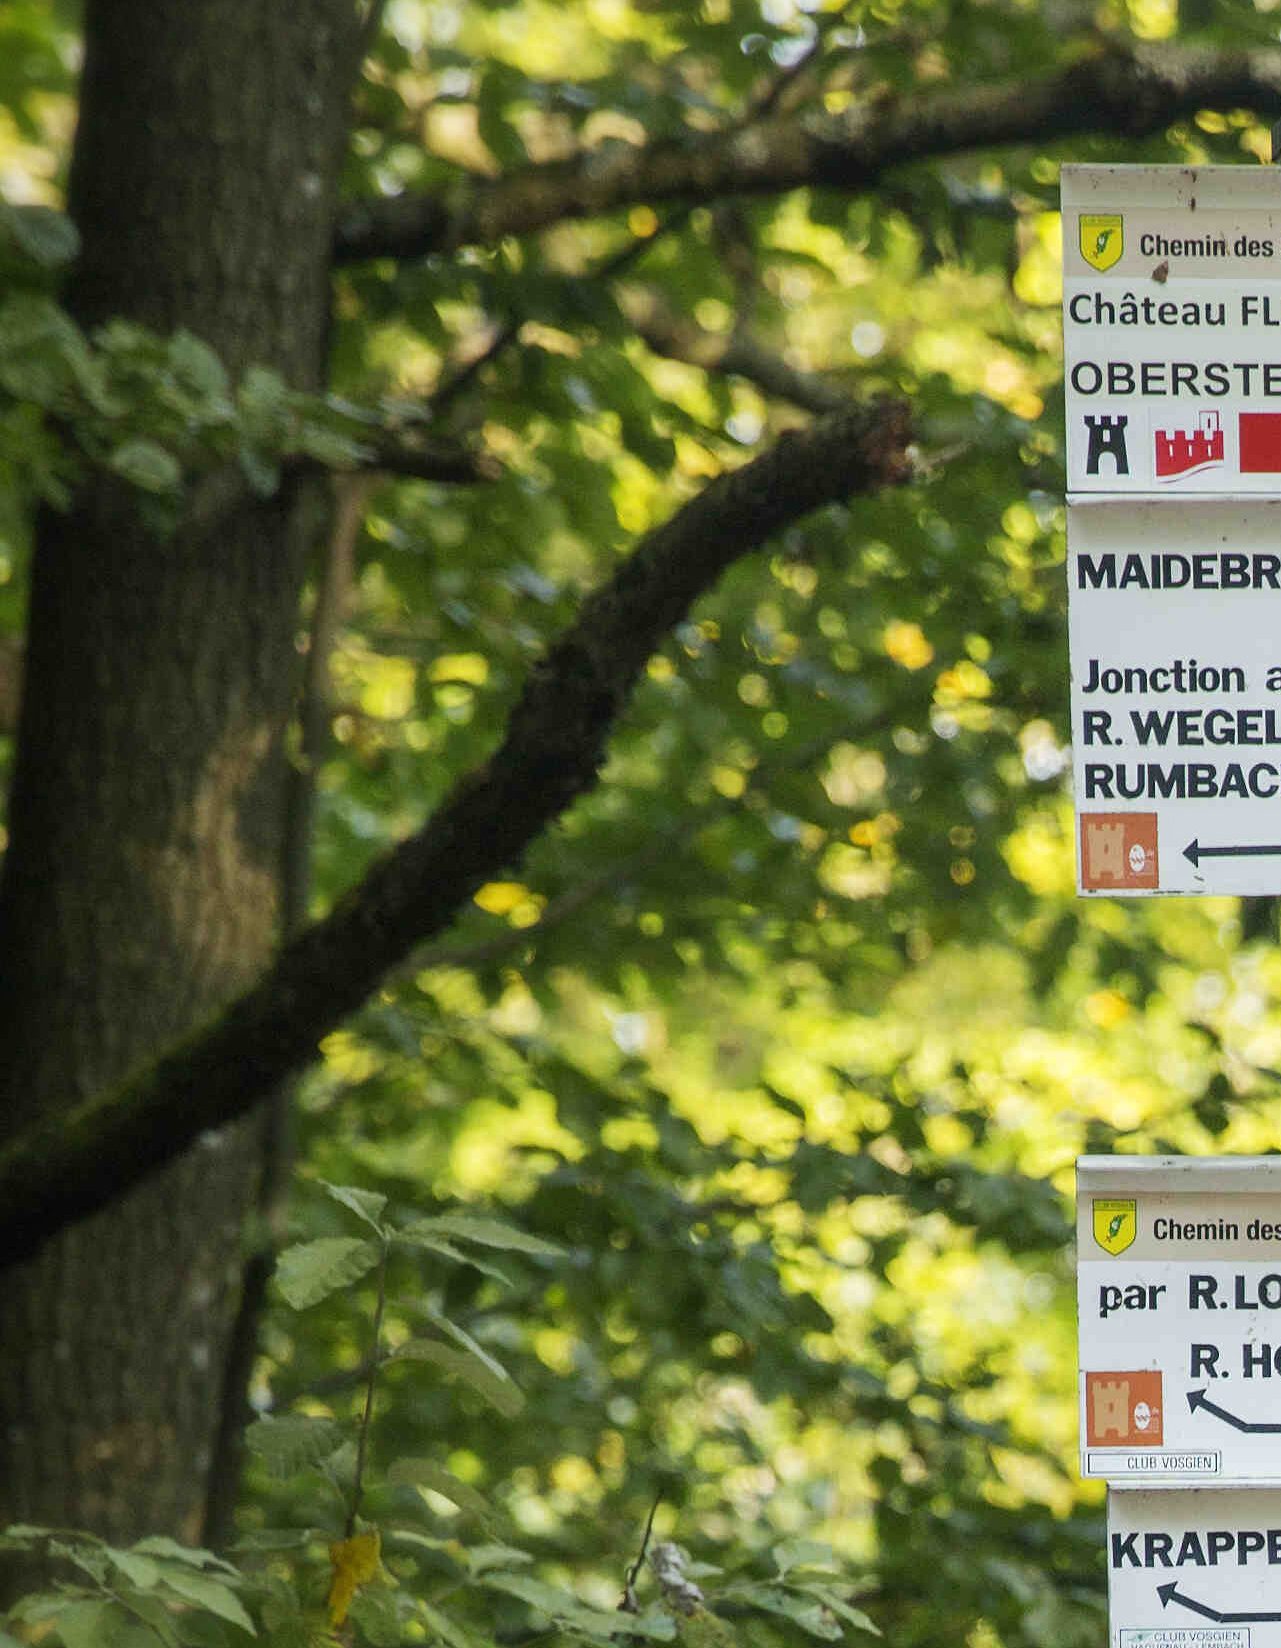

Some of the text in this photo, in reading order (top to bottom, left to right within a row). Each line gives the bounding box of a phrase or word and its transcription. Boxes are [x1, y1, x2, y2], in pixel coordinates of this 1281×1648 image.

[1141, 235, 1224, 256] Chemin
[1234, 236, 1273, 257] des
[1070, 293, 1225, 325] Château
[1083, 660, 1245, 693] Jonction
[1154, 1219, 1238, 1240] Chemin
[1100, 1285, 1166, 1318] par
[1191, 1344, 1229, 1378] R.
[1128, 1457, 1211, 1468] CLUB VOSGIEN
[1154, 1632, 1185, 1642] CLUB
